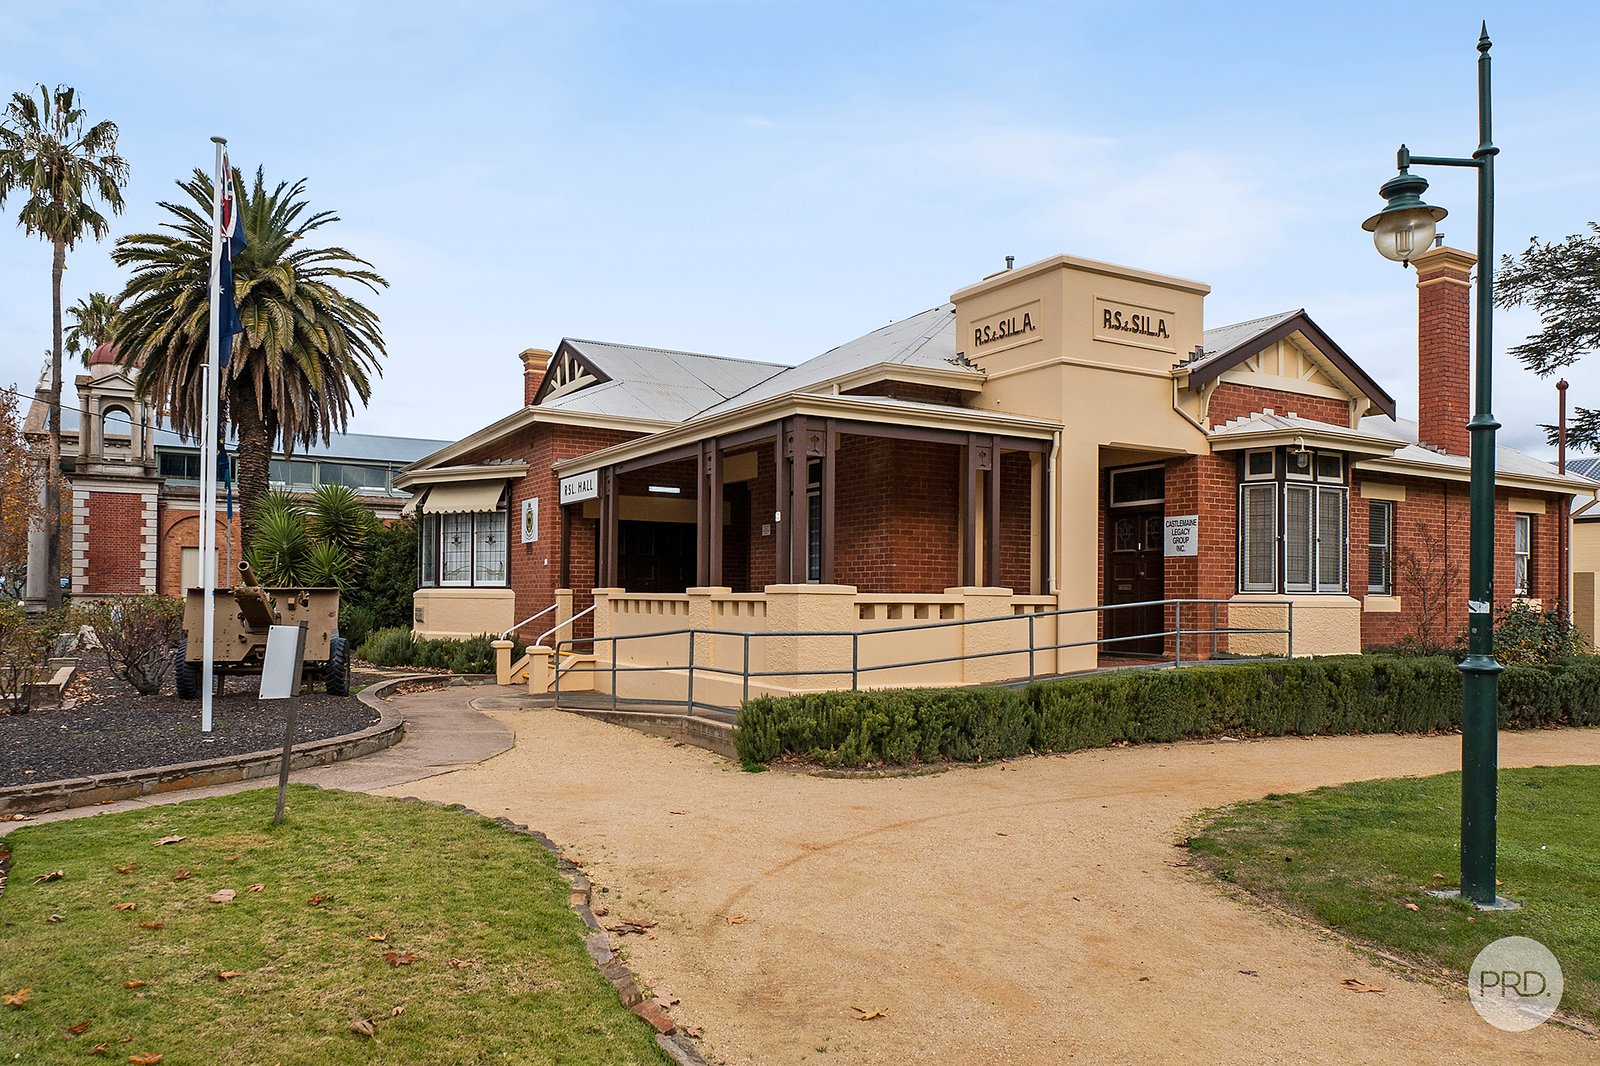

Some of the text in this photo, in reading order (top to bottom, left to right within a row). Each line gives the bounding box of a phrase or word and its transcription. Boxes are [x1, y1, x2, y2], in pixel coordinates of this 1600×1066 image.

[577, 479, 593, 493] HALL
[1165, 518, 1197, 528] CASTLEMAINE
[1171, 528, 1190, 536] LEGACY
[1172, 536, 1190, 545] GROUP
